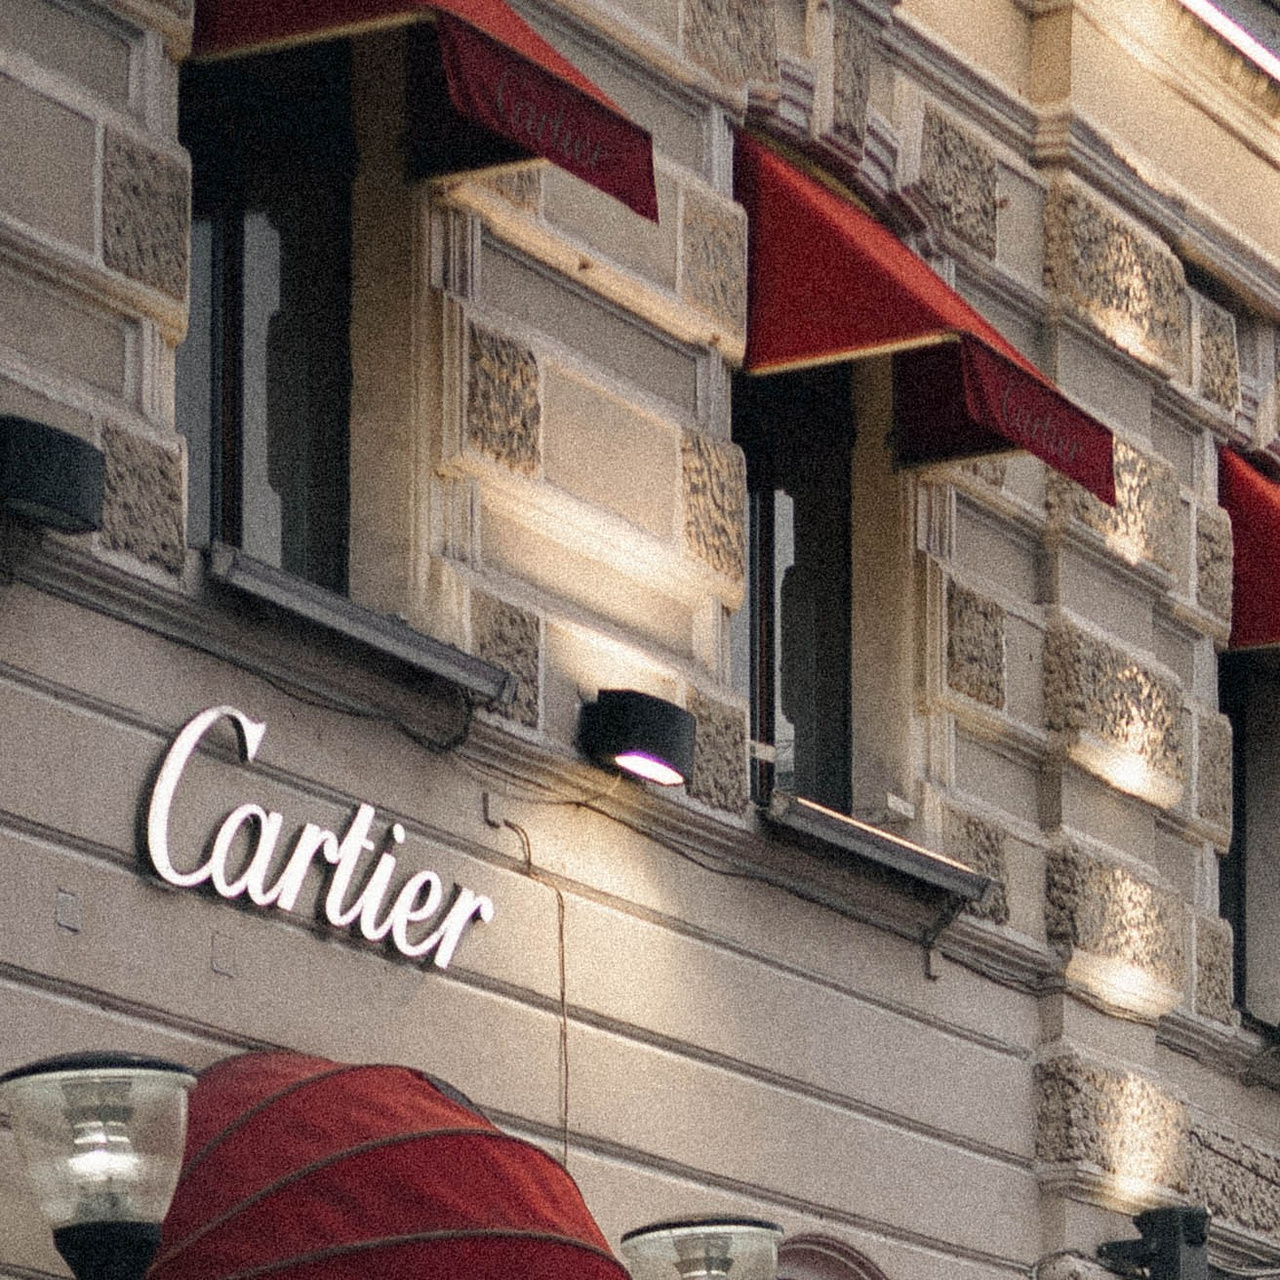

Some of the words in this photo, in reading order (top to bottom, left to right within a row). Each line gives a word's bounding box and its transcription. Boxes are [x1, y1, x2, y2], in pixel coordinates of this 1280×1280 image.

[496, 69, 609, 173] Cartier
[1002, 374, 1086, 463] Cartier
[147, 705, 494, 968] Cartier
